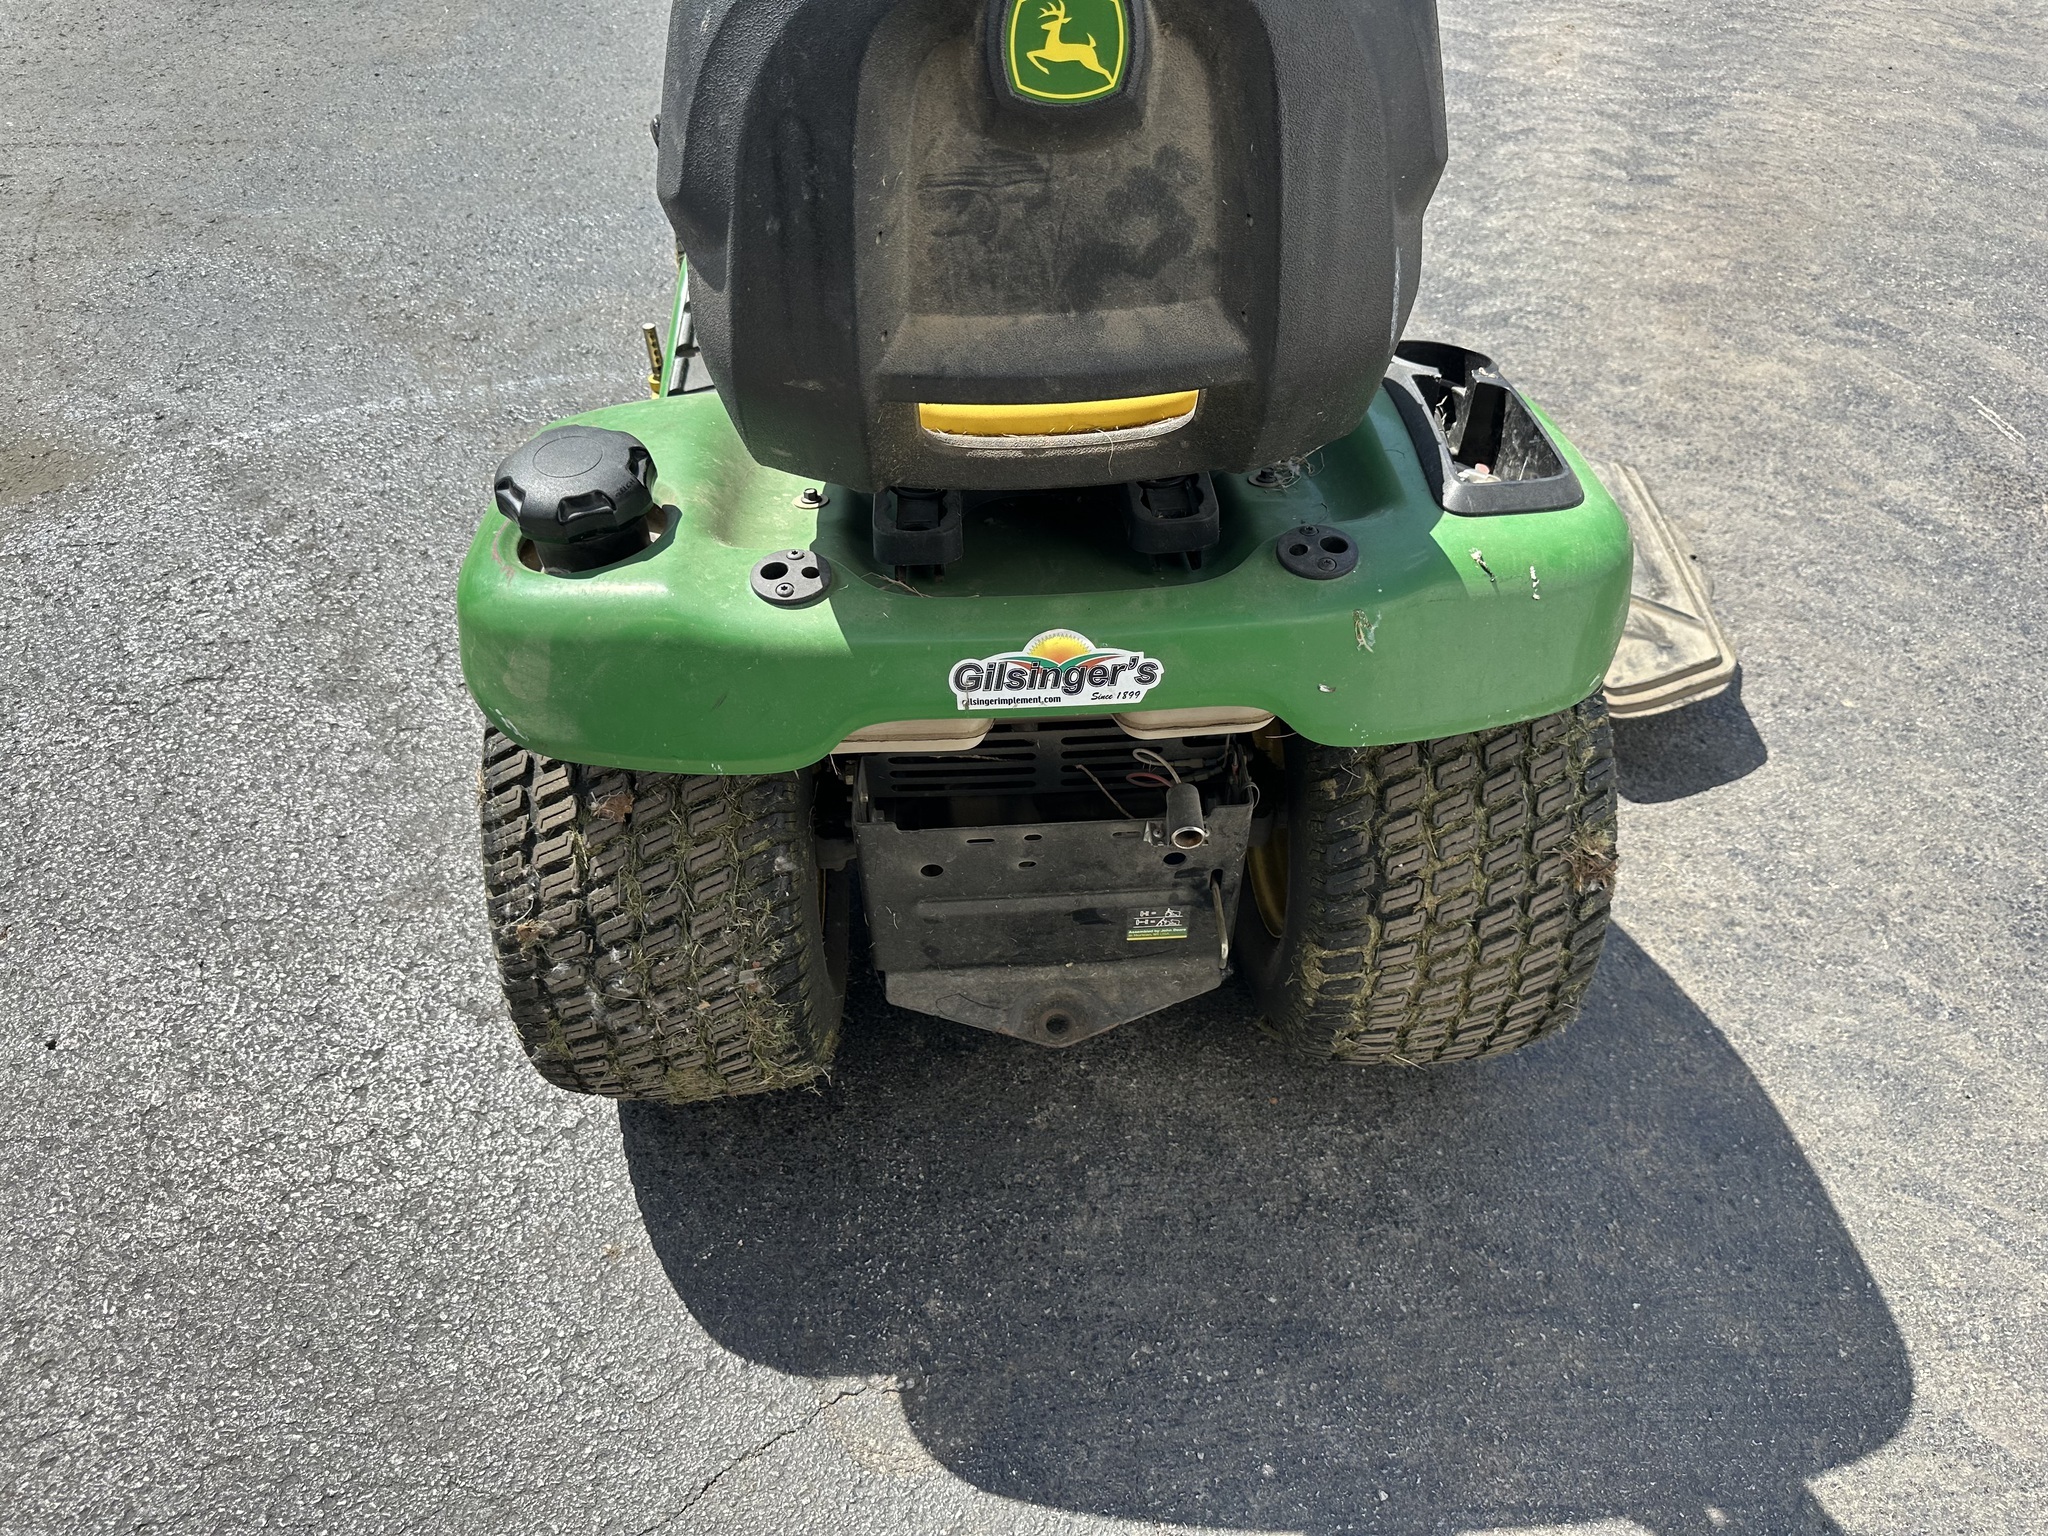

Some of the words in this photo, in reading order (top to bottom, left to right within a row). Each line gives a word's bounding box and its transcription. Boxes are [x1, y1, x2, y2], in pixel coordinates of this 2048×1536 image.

[953, 656, 1159, 696] Gilsinger's
[1091, 692, 1113, 701] Since
[1116, 690, 1141, 700] 1899
